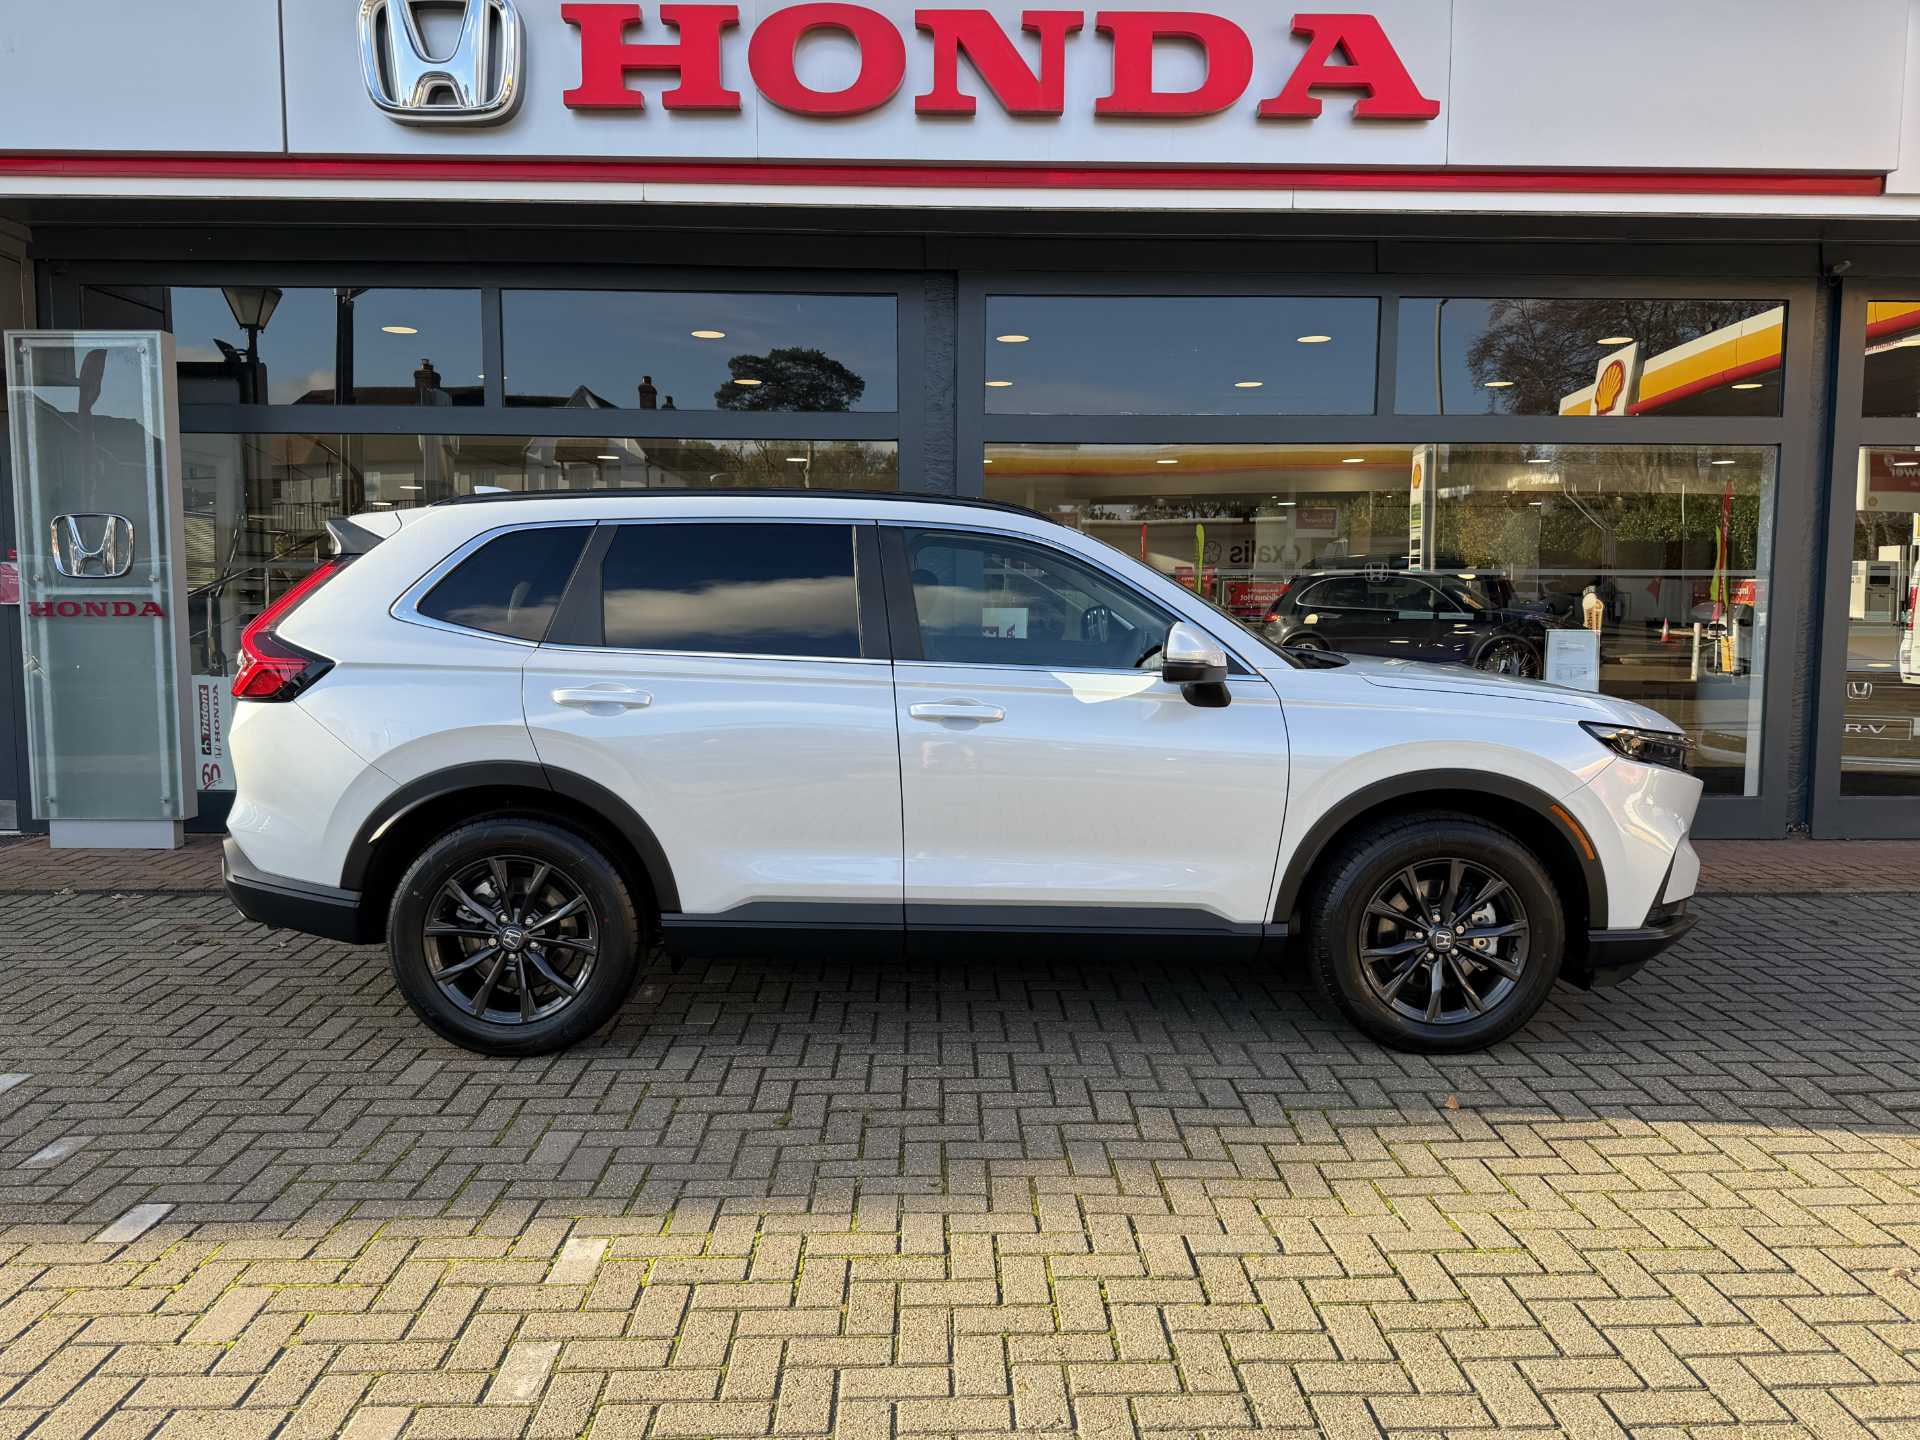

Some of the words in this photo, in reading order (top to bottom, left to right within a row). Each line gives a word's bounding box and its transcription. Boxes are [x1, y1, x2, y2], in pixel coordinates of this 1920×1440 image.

[561, 2, 1442, 121] HONDA
[28, 601, 168, 618] HONDA
[200, 687, 209, 736] Trident
[213, 683, 221, 743] HONDA
[1845, 723, 1888, 734] R-V
